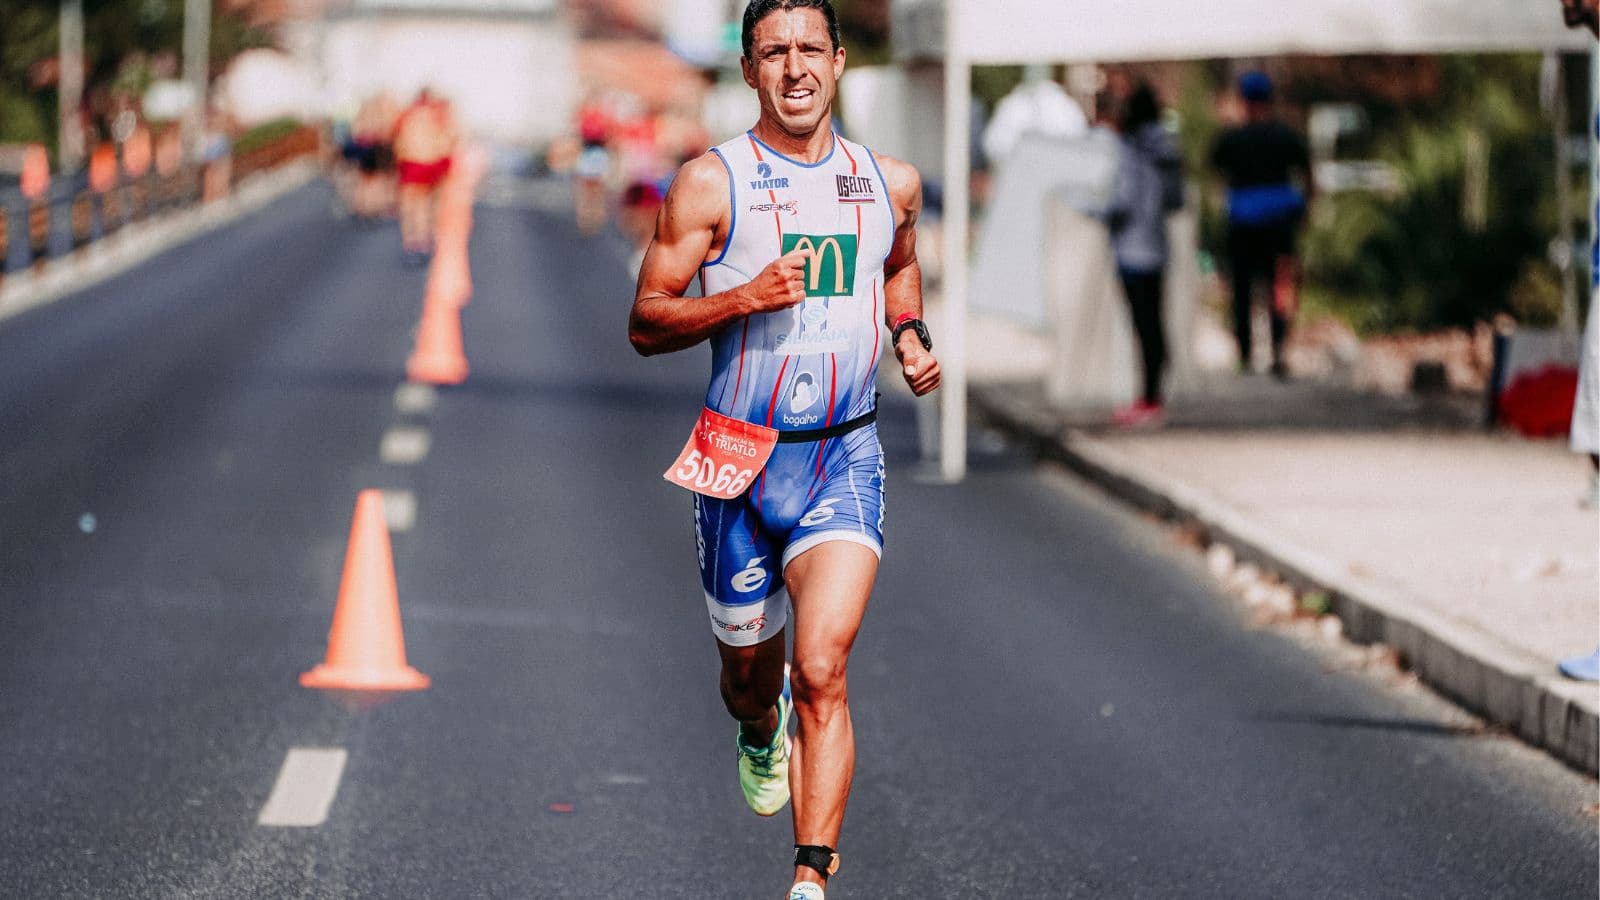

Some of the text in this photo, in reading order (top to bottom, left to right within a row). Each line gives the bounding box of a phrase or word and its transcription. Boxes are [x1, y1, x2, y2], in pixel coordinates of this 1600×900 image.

[751, 178, 789, 190] VIATOR
[783, 414, 817, 426] bogalho
[715, 438, 757, 457] TRIATLO
[677, 449, 752, 495] 5066
